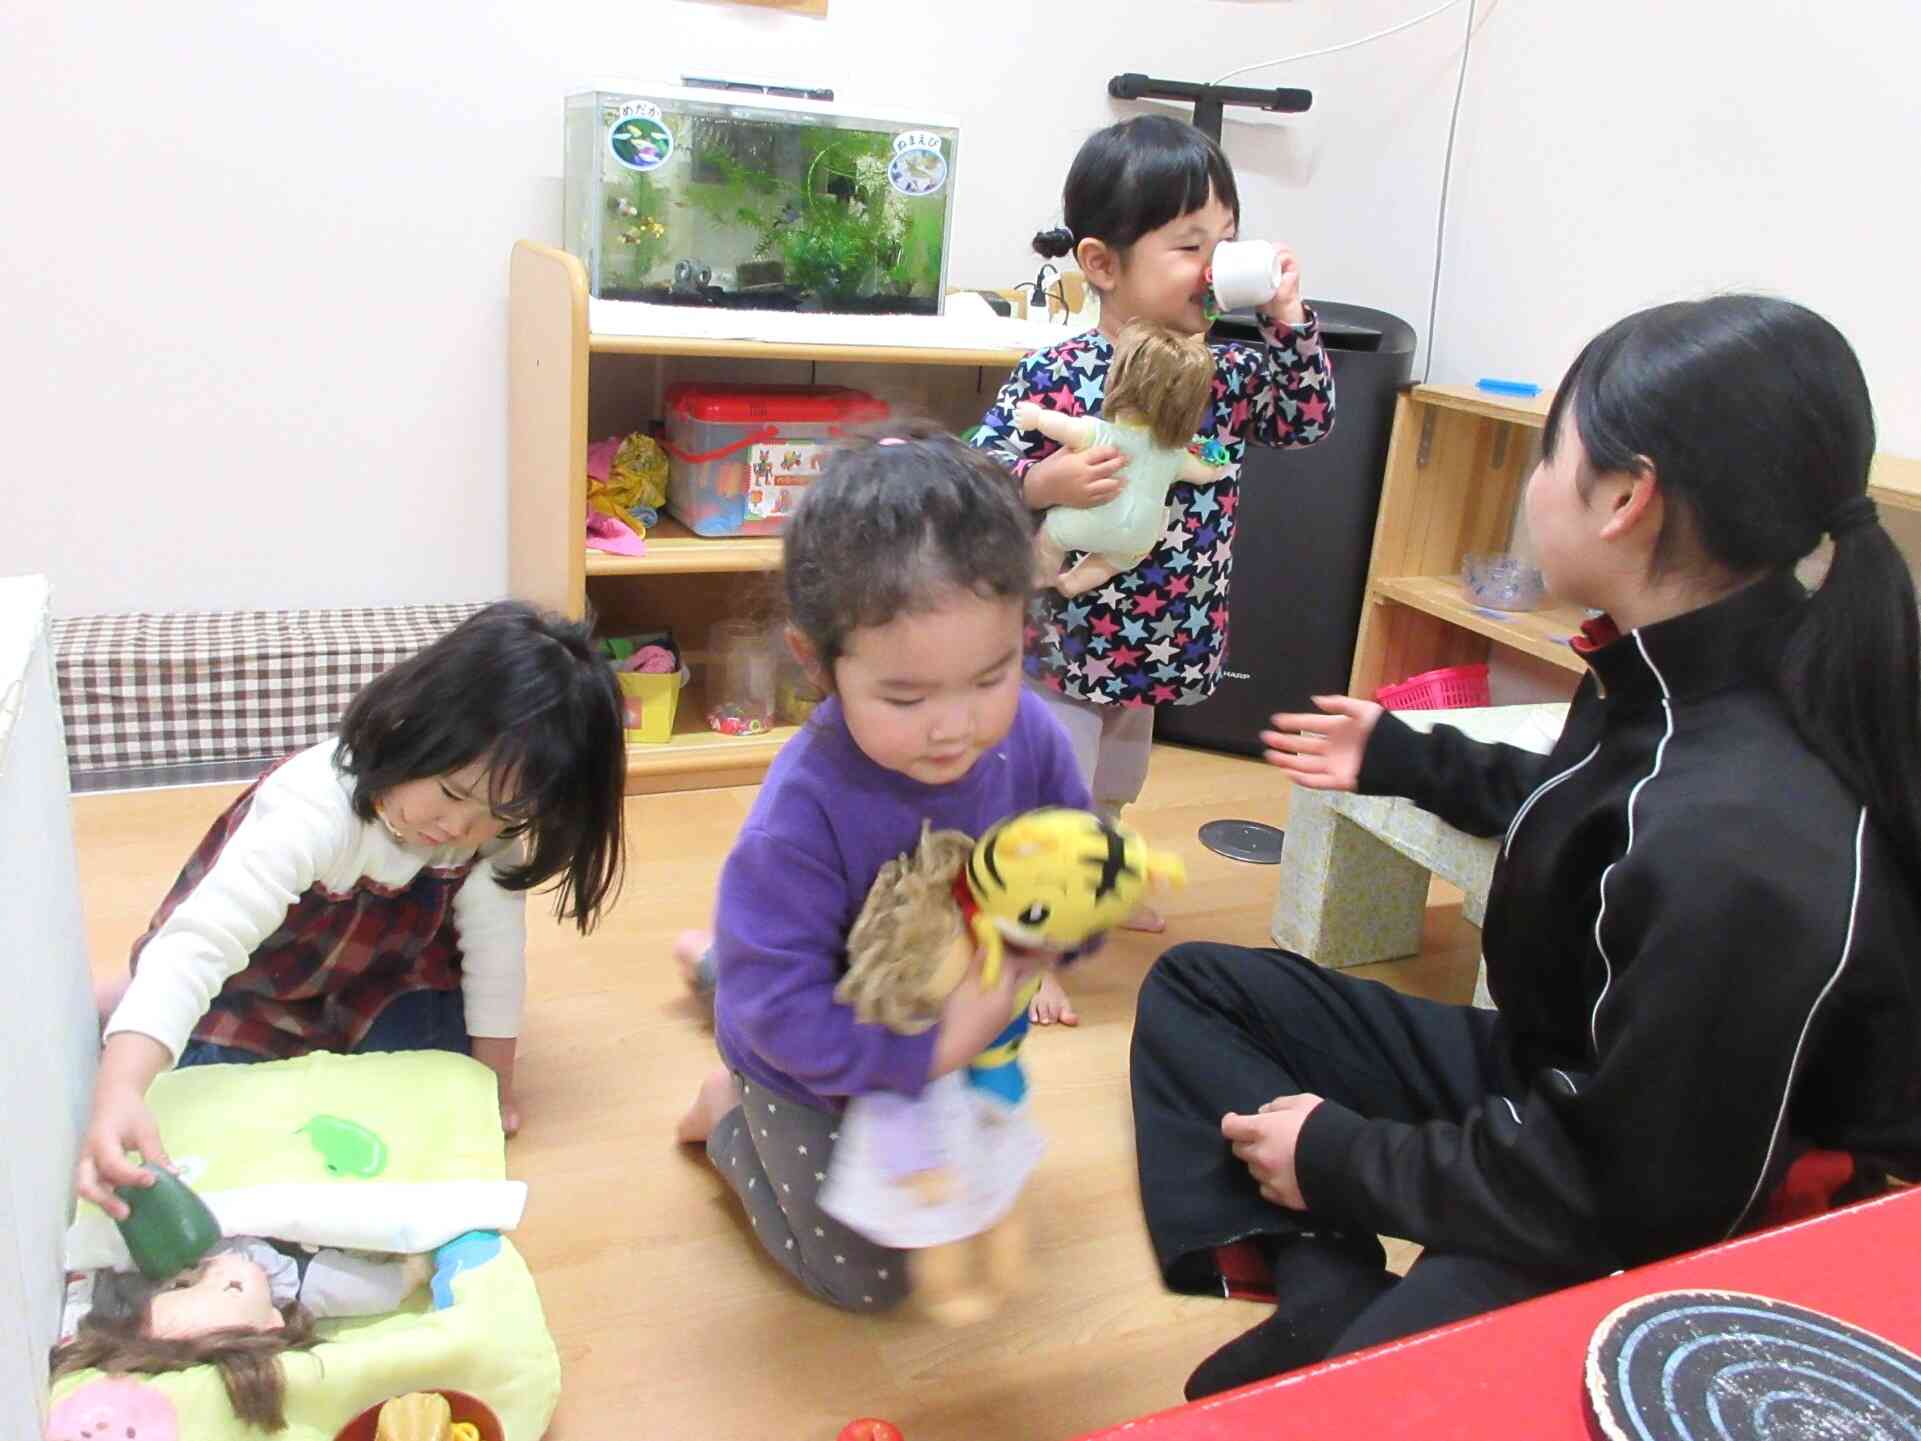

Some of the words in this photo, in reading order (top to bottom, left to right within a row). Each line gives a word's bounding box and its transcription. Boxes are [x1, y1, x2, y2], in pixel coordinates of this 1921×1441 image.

[622, 103, 660, 116] めだか
[1222, 670, 1250, 679] HARP
